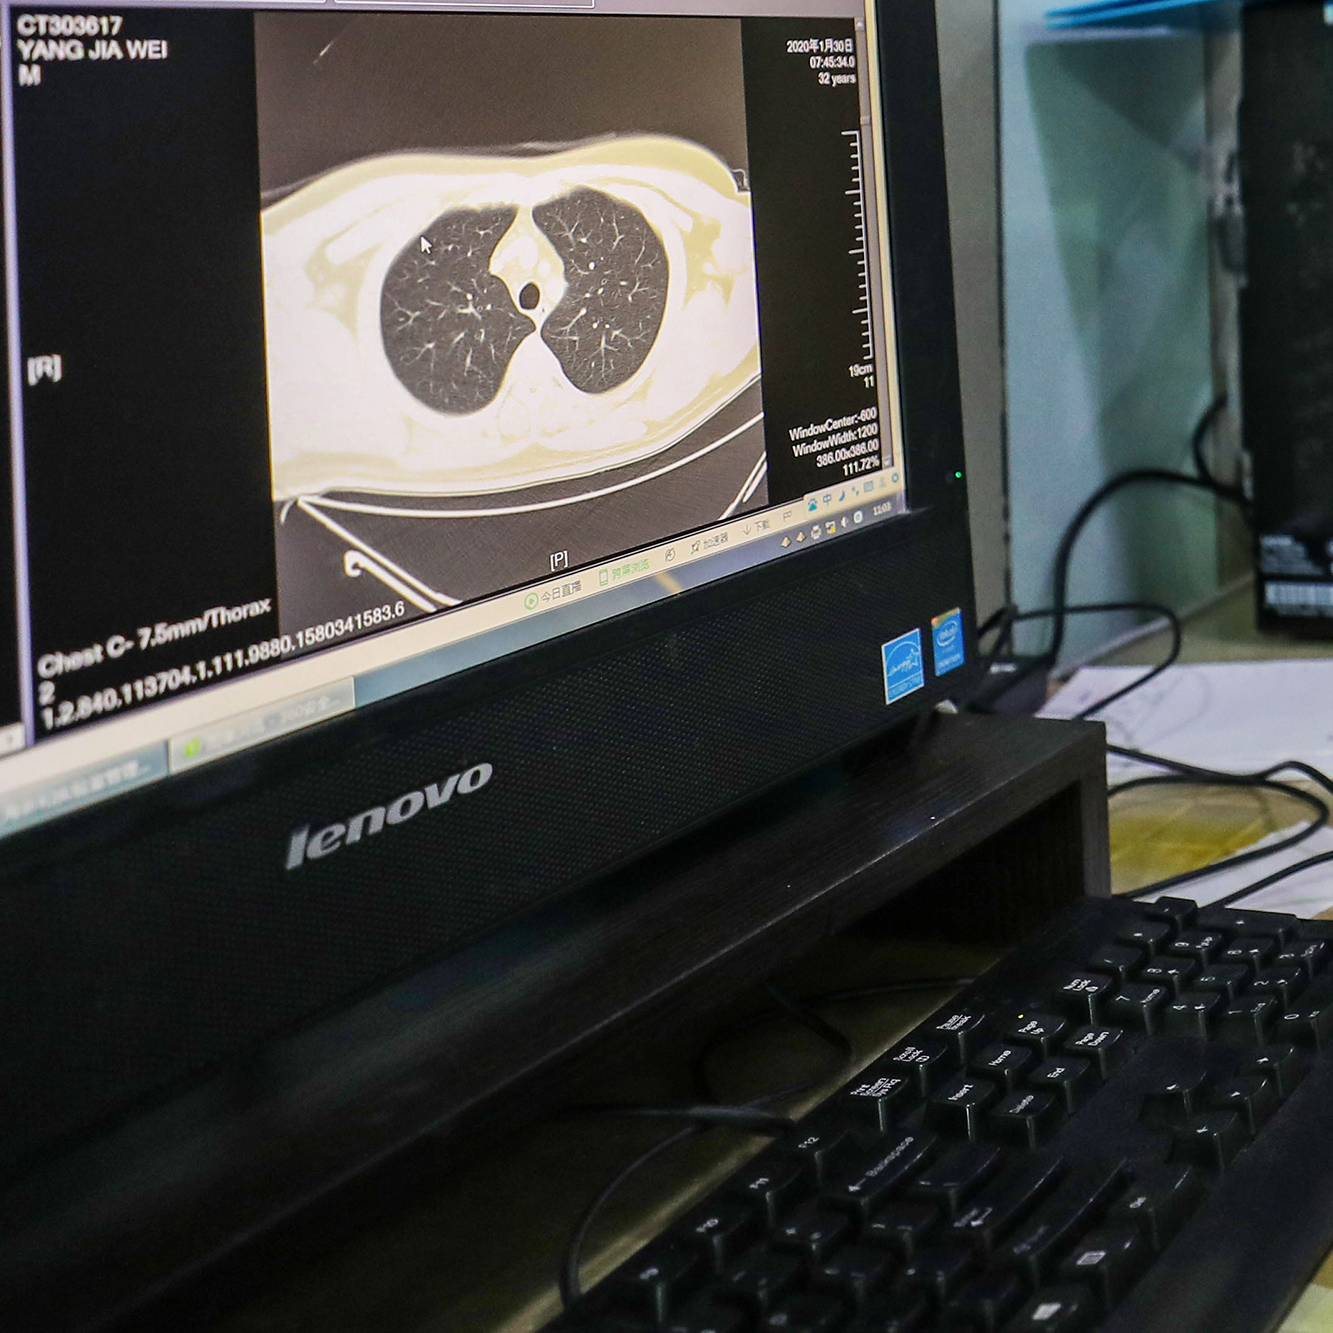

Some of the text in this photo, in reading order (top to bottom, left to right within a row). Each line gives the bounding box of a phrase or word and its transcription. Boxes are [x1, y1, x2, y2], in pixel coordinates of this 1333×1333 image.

[17, 14, 123, 37] CT303617
[17, 39, 168, 61] YANG JIA WEI
[786, 38, 854, 54] 2020年1月30日
[809, 55, 855, 69] 07:45:34.0
[18, 64, 41, 87] M
[818, 72, 856, 87] 32 years
[848, 364, 873, 378] 19cm
[789, 406, 877, 442] WindowCenter:-600
[792, 422, 878, 458] WindowWidth:1200
[816, 438, 880, 468] 386.00x386.00
[842, 456, 880, 477] 111.72%
[549, 550, 569, 572] [P]
[38, 643, 103, 678] Chest
[137, 597, 272, 651] 7.5mm/Thorax
[285, 762, 493, 871] lenovo
[988, 1049, 1012, 1066] Home
